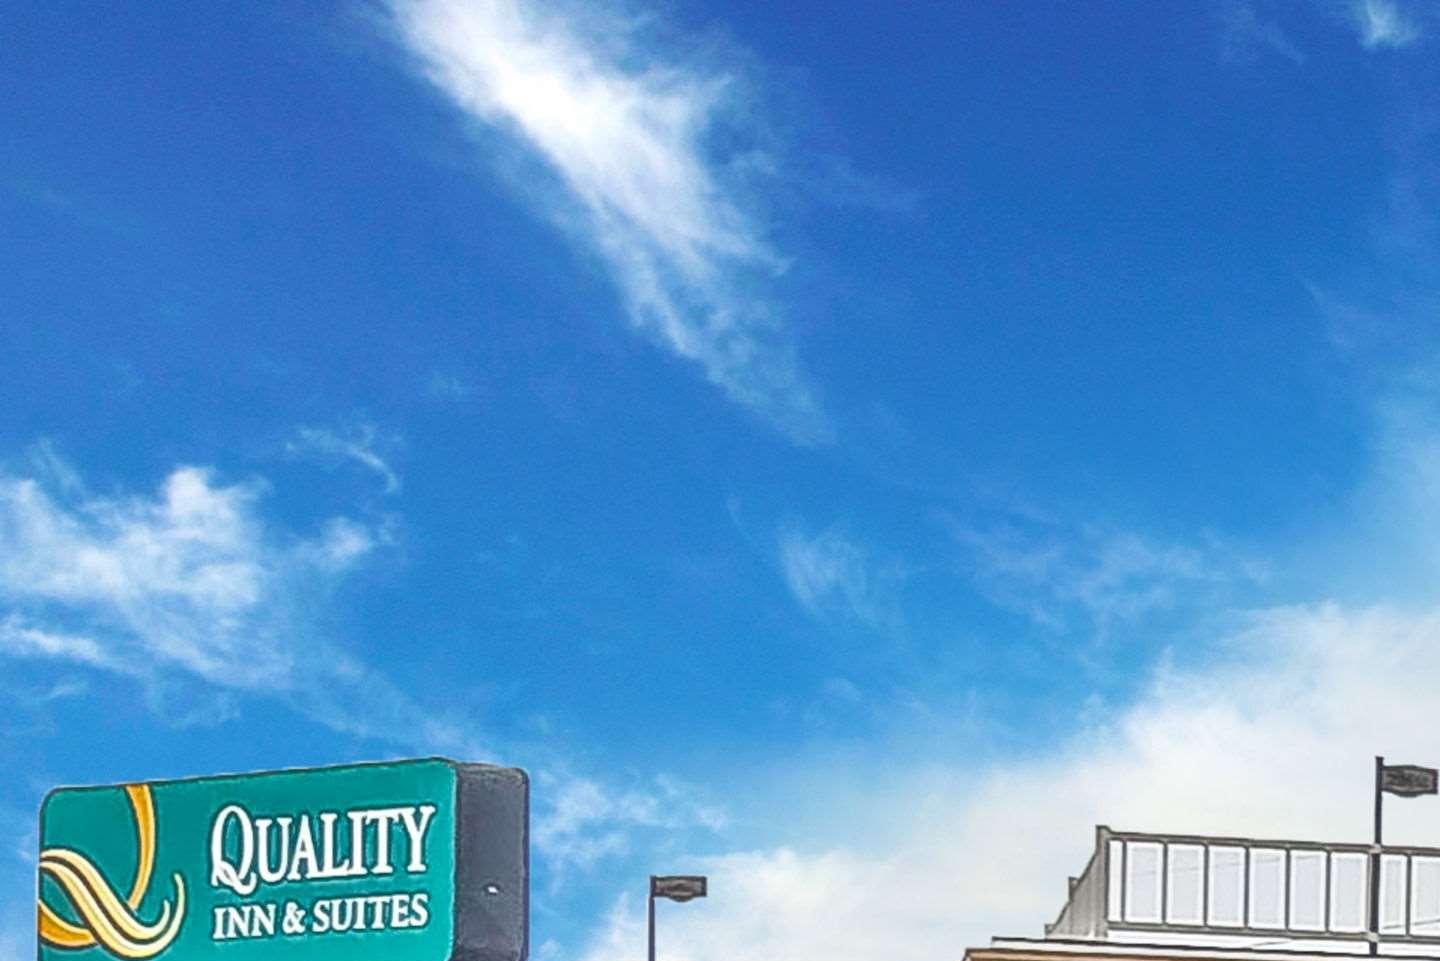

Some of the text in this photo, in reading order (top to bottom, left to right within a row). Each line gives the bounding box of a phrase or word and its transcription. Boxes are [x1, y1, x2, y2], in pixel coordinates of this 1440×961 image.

[211, 805, 435, 895] QUALITY
[212, 893, 429, 939] INN & SUITES
